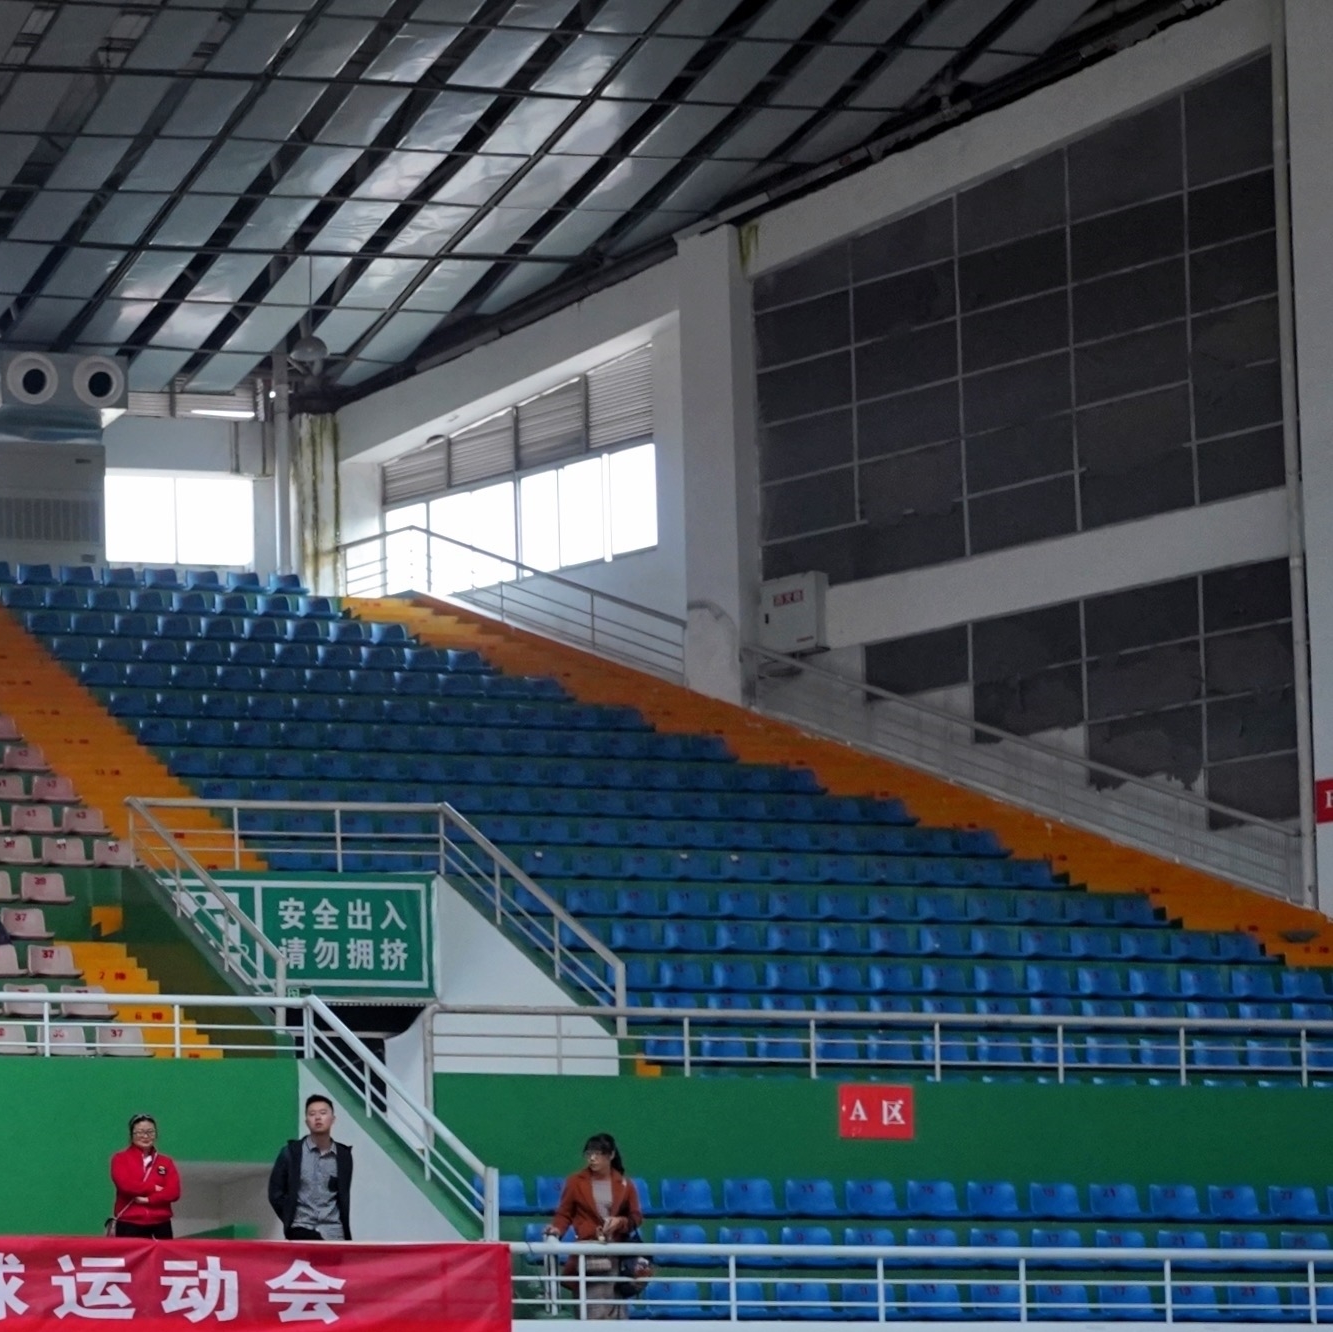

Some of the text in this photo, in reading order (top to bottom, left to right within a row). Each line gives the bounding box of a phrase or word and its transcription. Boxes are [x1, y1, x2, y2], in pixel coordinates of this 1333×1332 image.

[14, 912, 27, 922] 37
[278, 897, 408, 931] 安全出入
[42, 949, 54, 959] 37
[280, 937, 409, 972] 请勿拥挤
[110, 1029, 123, 1038] 37
[849, 1099, 906, 1125] A 区
